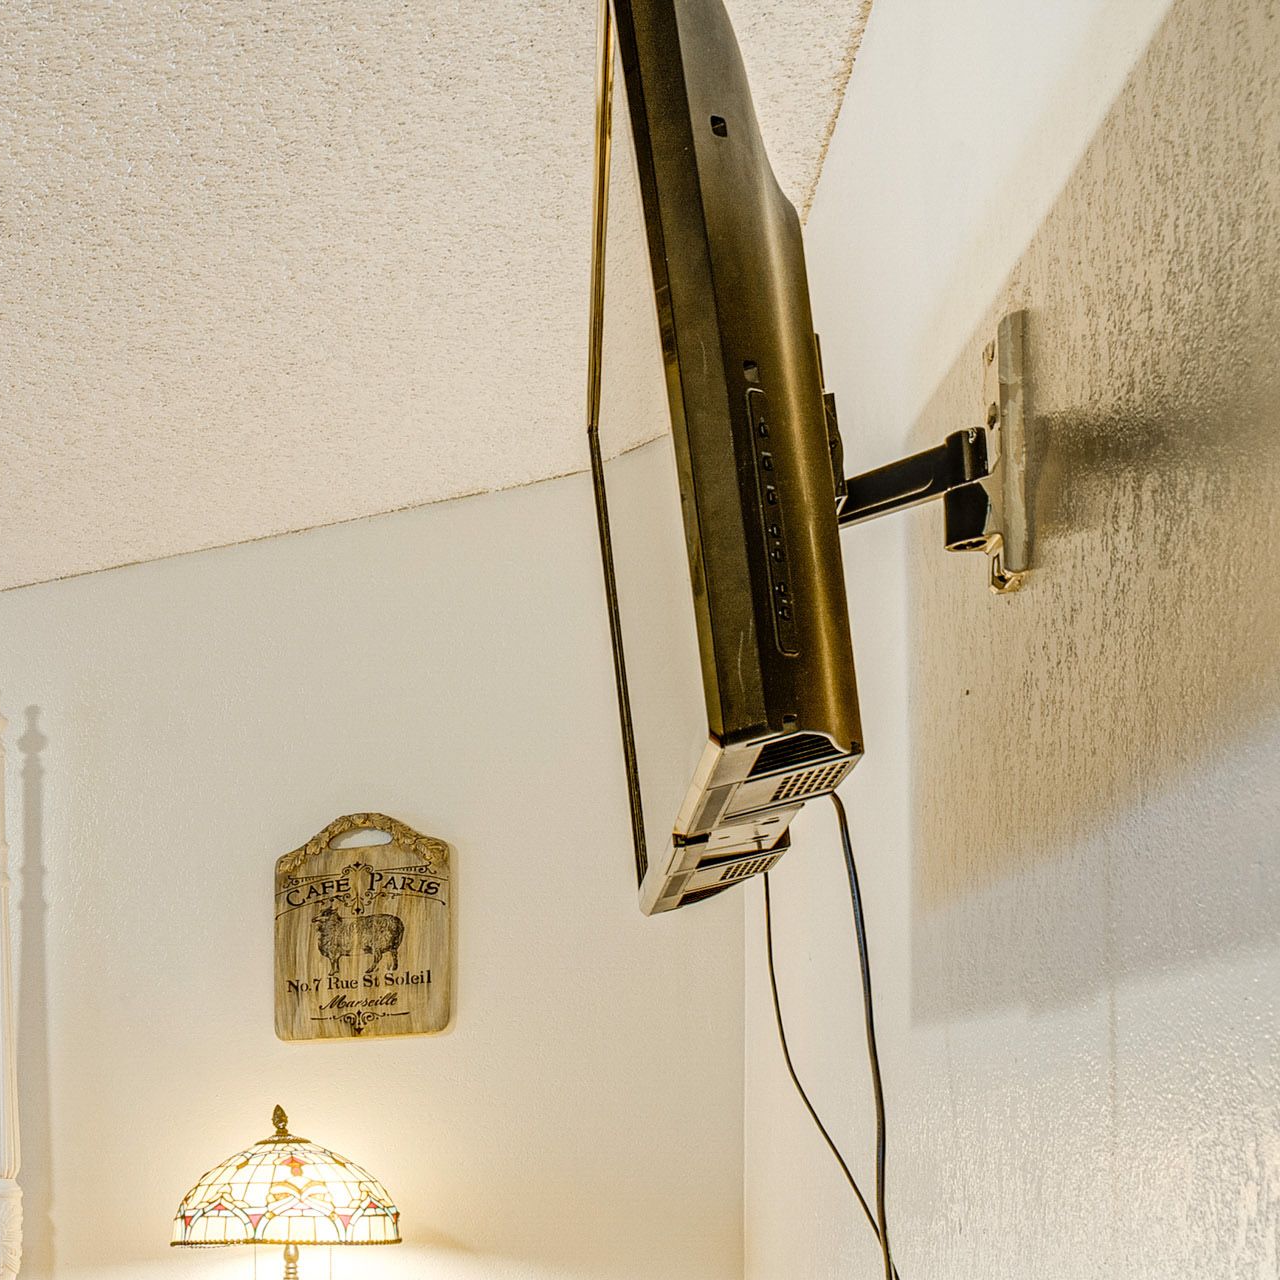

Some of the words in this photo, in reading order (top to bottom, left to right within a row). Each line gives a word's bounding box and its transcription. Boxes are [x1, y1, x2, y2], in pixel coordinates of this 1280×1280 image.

[368, 872, 441, 896] PARIS
[327, 976, 358, 990] Rue
[363, 974, 380, 988] St
[384, 970, 432, 986] Soleil
[319, 992, 398, 1010] Marseille
